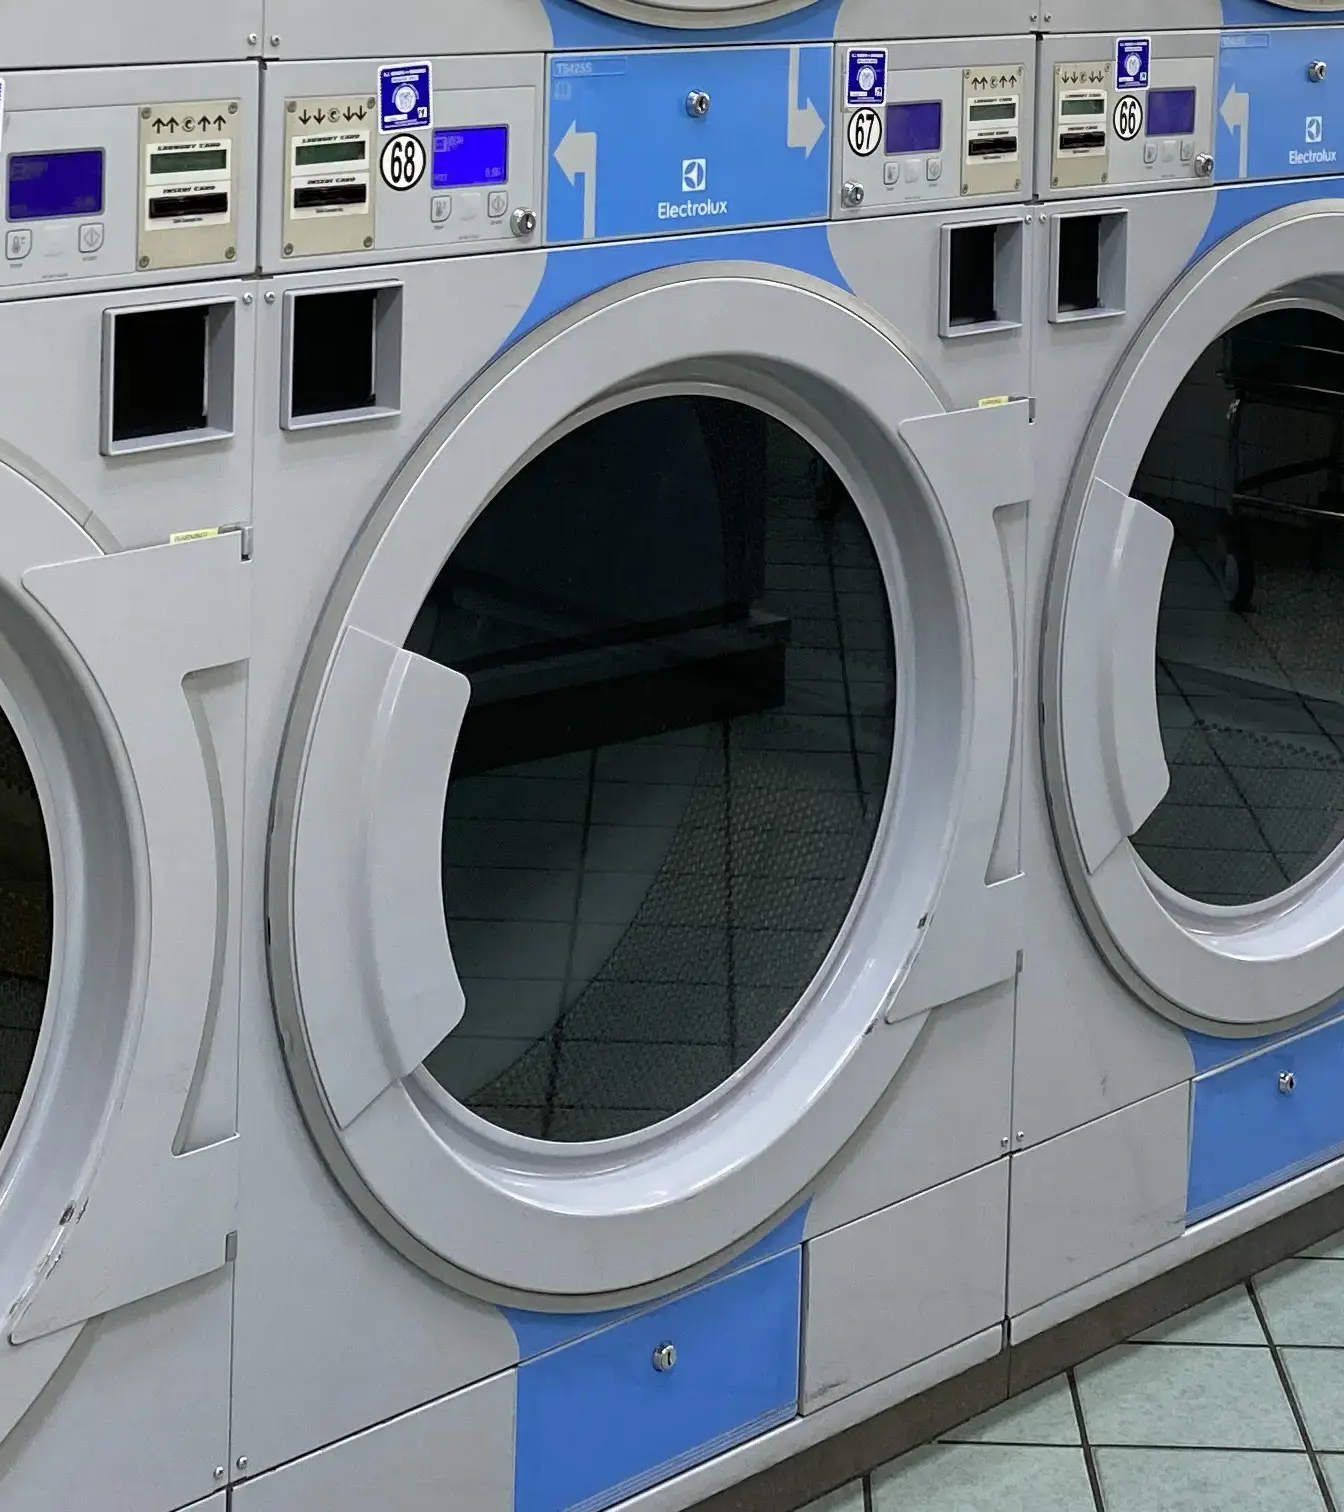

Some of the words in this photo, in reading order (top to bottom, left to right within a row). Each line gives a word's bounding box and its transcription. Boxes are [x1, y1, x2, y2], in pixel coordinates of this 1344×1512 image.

[855, 112, 875, 151] 67
[1119, 100, 1137, 135] 66
[390, 140, 415, 183] 68
[1288, 148, 1337, 165] Electrolux
[657, 198, 728, 220] Electrolux
